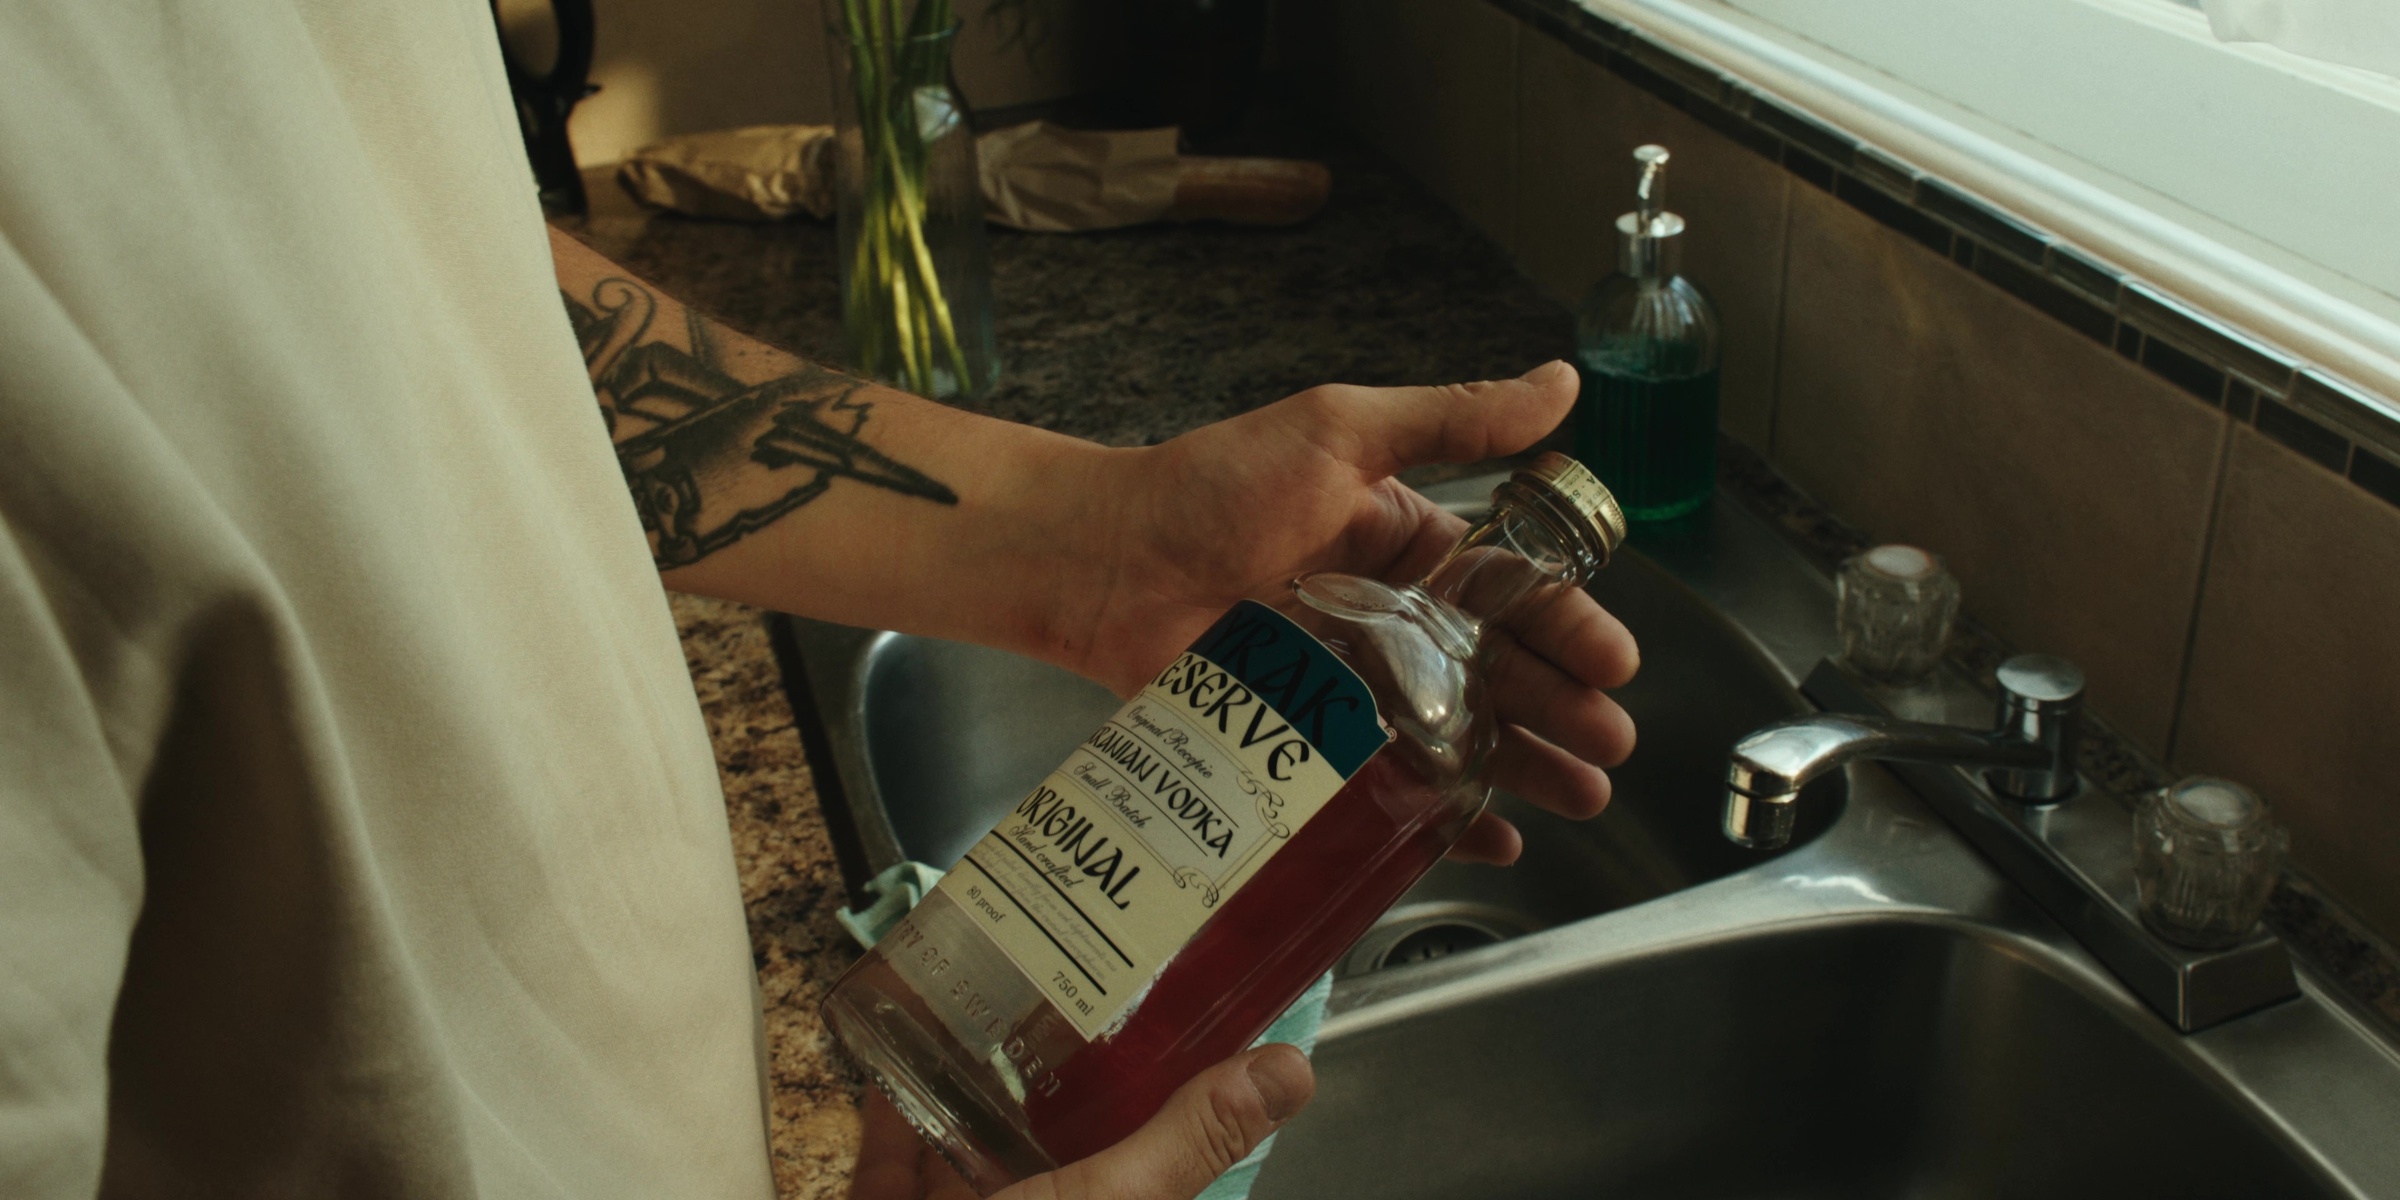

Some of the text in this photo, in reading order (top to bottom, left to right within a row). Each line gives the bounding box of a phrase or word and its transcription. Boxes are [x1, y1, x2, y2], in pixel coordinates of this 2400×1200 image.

[1206, 609, 1360, 748] YRAK
[1151, 652, 1310, 781] ESERVE
[1164, 728, 1213, 779] Recepie
[1074, 762, 1152, 829] Small Batch
[1088, 726, 1234, 859] RANIAN VODKA
[1008, 824, 1047, 853] Hand
[1036, 852, 1084, 888] crafted
[1016, 785, 1140, 910] ORIGINAL
[966, 885, 982, 900] 80
[975, 897, 1007, 923] proof
[1052, 970, 1078, 999] 750
[1075, 997, 1095, 1016] ml
